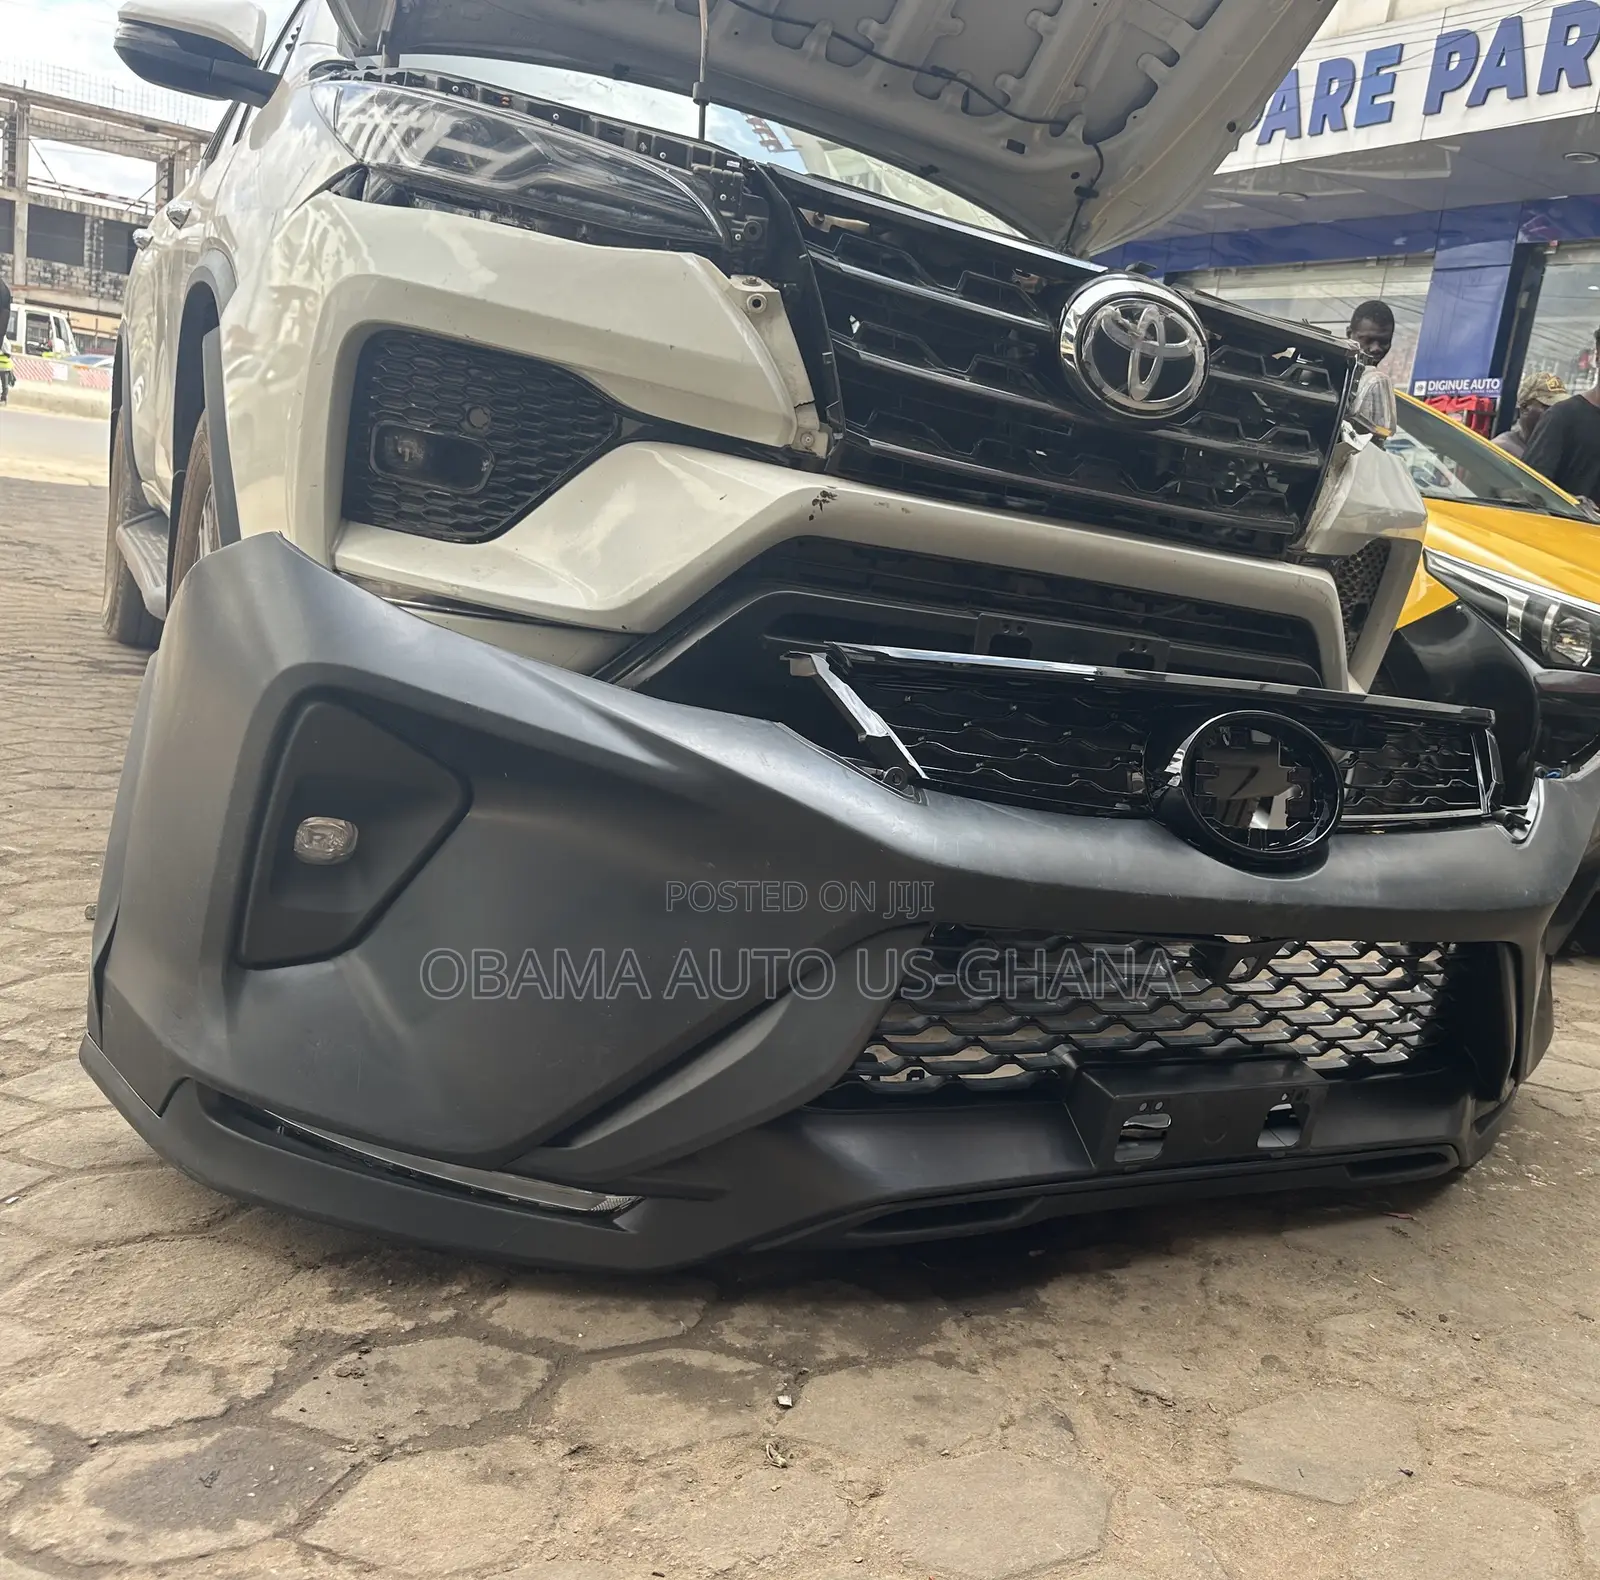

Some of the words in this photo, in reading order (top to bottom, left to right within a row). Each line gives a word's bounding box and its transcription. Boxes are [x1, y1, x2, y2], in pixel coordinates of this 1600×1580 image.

[1249, 42, 1404, 146] ARE
[1423, 0, 1600, 116] PAR
[1470, 378, 1500, 389] AUTO
